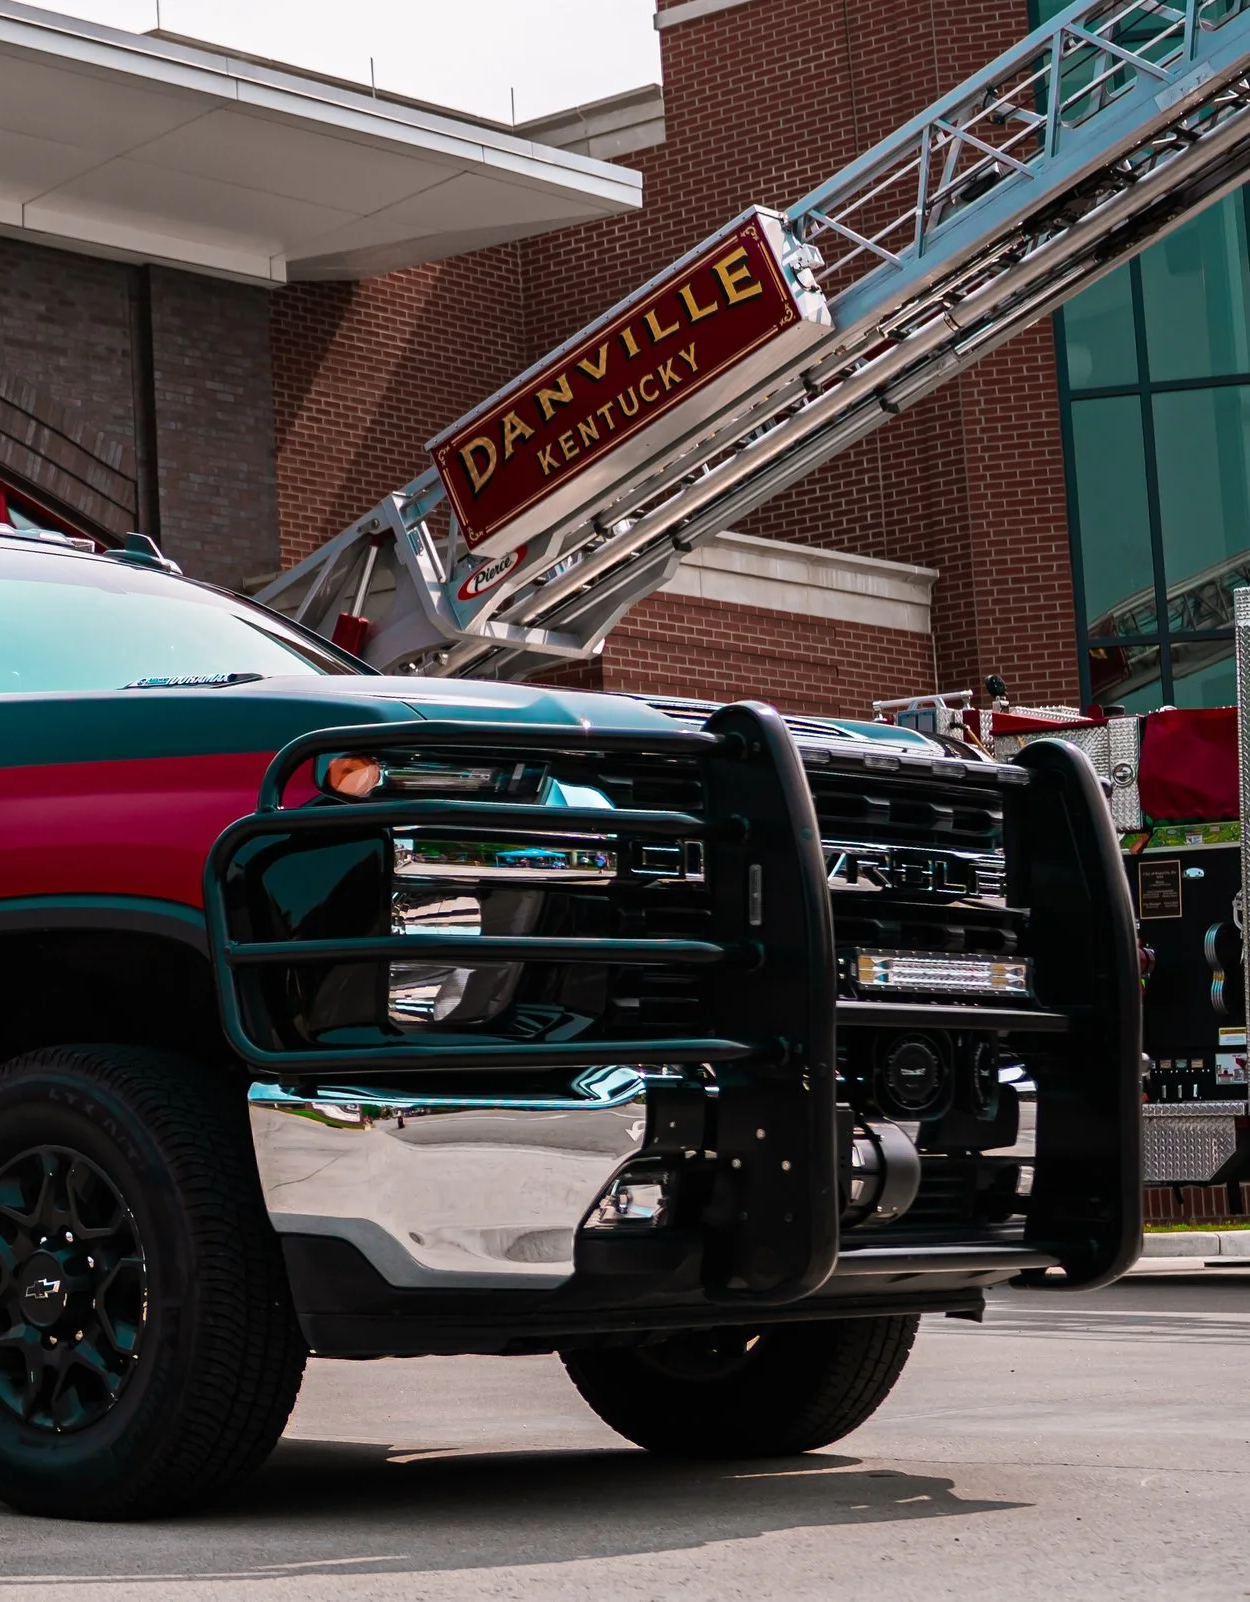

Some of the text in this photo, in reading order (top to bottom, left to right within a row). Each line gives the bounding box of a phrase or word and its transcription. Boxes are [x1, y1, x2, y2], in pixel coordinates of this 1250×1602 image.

[458, 246, 763, 494] DANVILLE
[535, 341, 699, 476] KENTUCKY
[473, 556, 511, 593] Pierce
